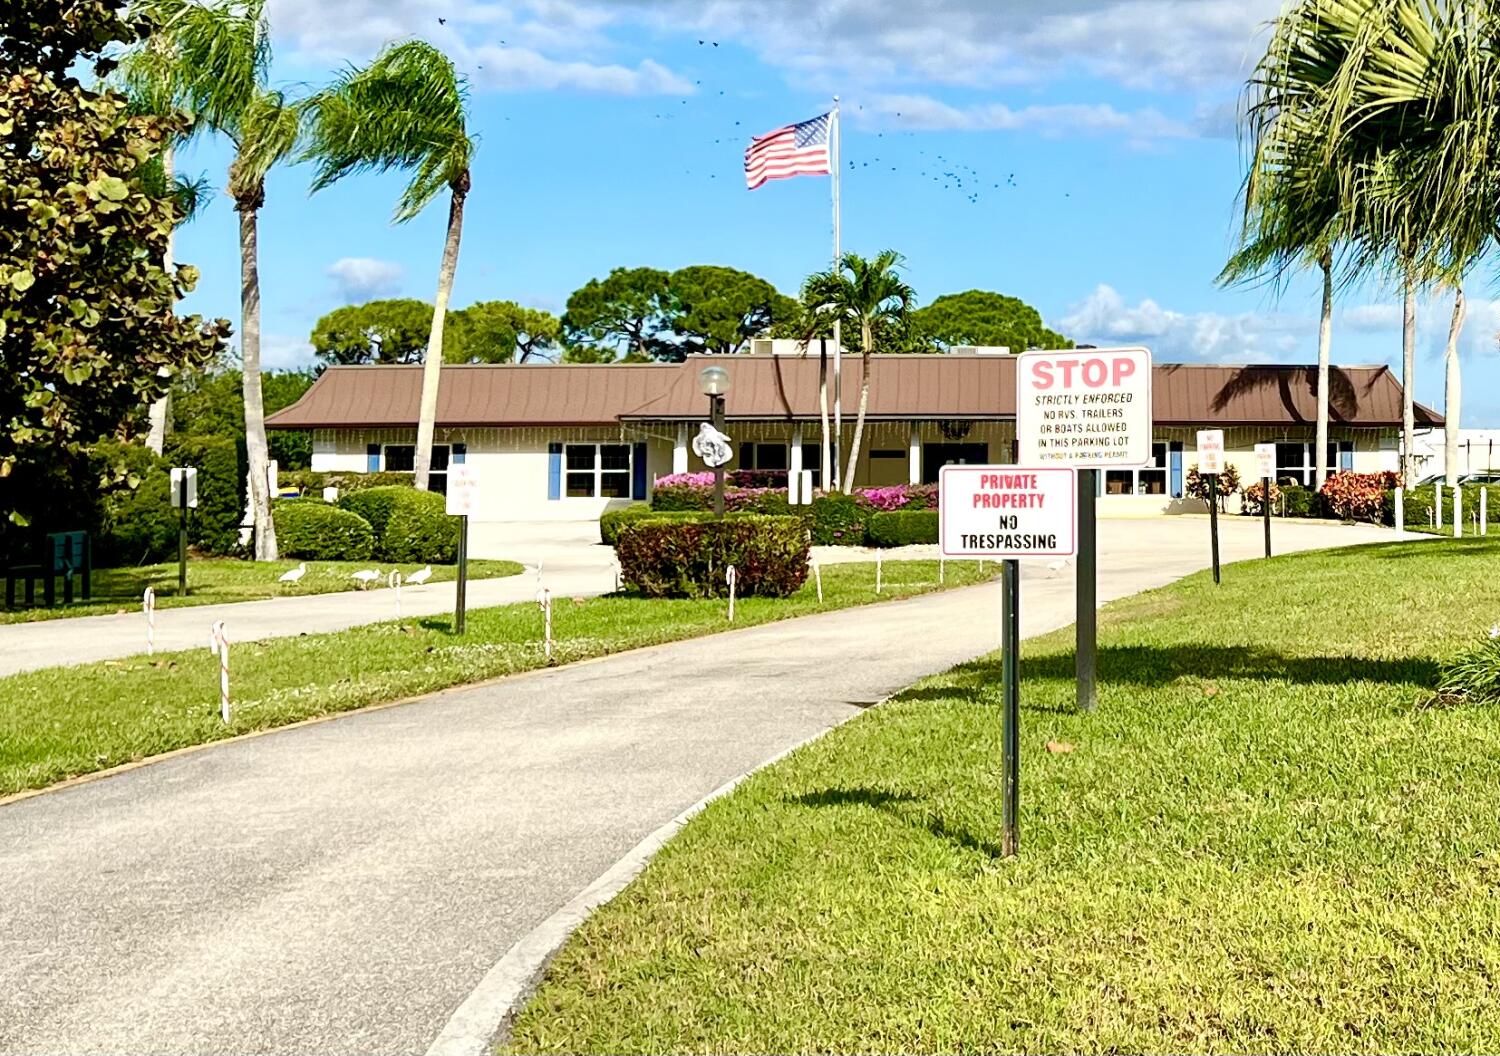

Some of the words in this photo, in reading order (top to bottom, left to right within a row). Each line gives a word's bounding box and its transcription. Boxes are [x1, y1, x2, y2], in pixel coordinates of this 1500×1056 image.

[1032, 358, 1135, 390] STOP
[1035, 394, 1080, 406] STRICTLY
[1082, 393, 1133, 405] ENFORCED
[1043, 410, 1056, 420] NO
[1082, 408, 1123, 419] TRAILERS
[1040, 424, 1052, 434] OR
[1055, 424, 1083, 434] BOATS
[1086, 422, 1127, 433] ALLOWED
[1038, 439, 1047, 448] IN
[1050, 438, 1069, 448] THIS
[1071, 437, 1110, 447] PARKING
[1113, 436, 1129, 446] LOT
[980, 474, 1038, 490] PRIVATE
[972, 493, 1045, 509] PROPERTY
[999, 515, 1018, 530] NO
[960, 534, 1057, 549] TRESPASSING
